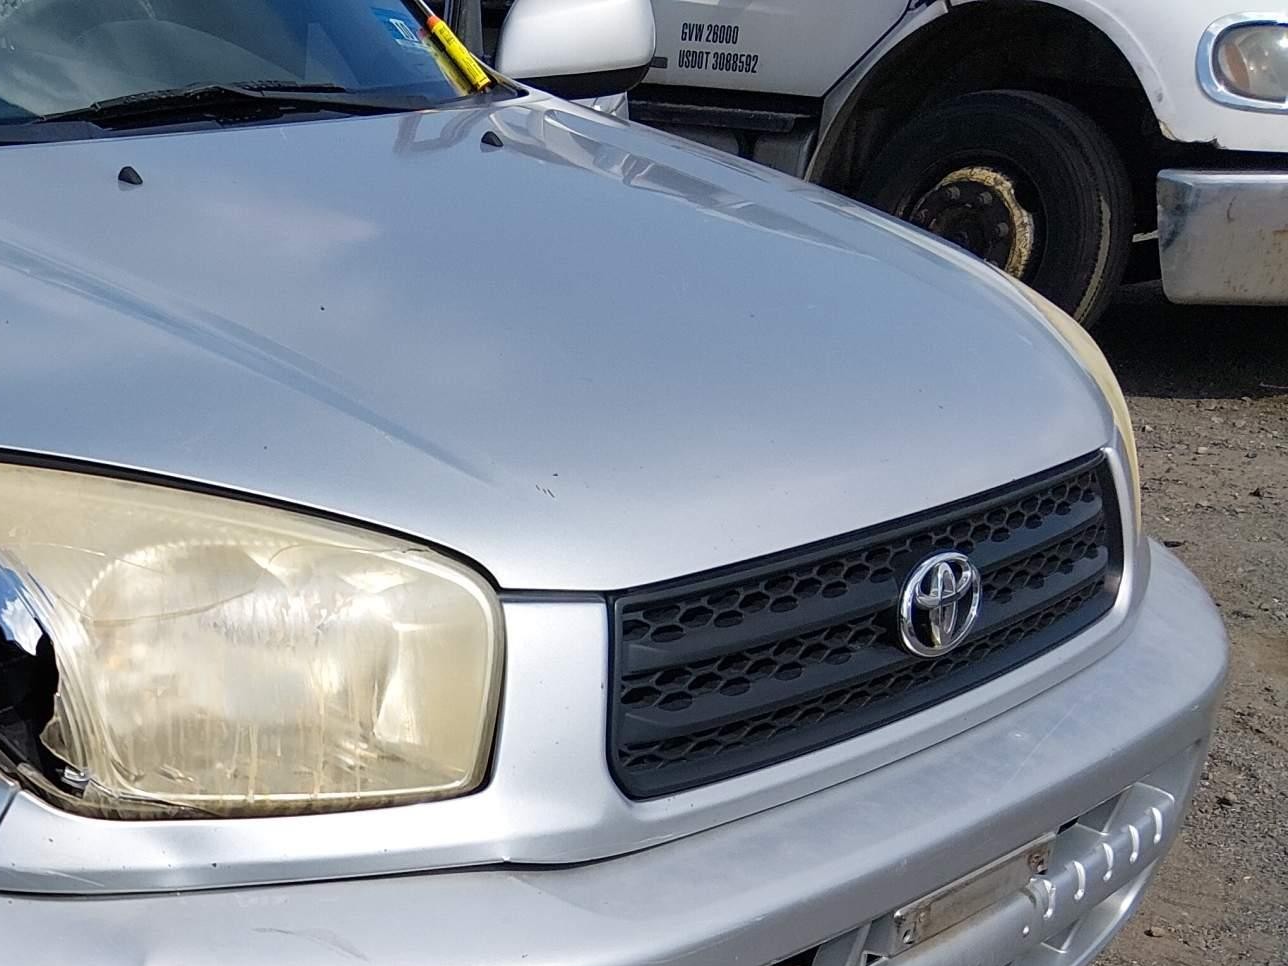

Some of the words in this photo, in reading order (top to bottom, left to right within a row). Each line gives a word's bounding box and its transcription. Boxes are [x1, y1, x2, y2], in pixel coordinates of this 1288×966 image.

[681, 22, 705, 42] GVW
[705, 24, 739, 44] 26000
[678, 49, 711, 70] USDOT
[712, 52, 759, 73] 3088592
